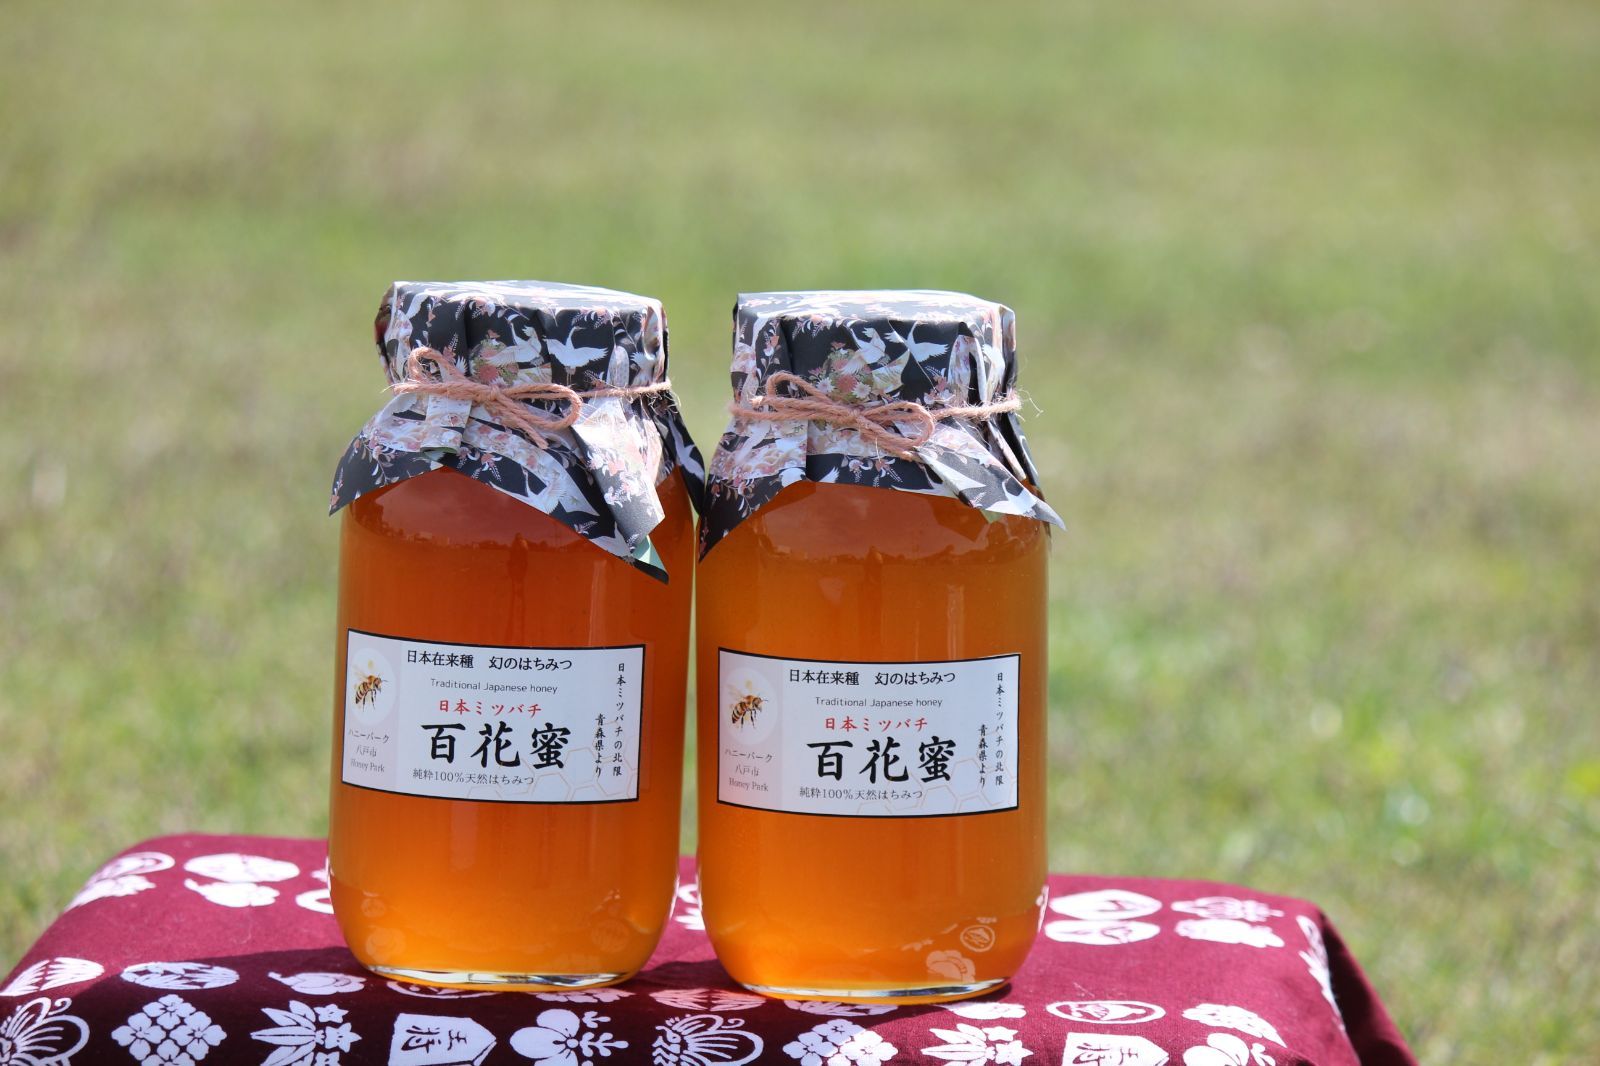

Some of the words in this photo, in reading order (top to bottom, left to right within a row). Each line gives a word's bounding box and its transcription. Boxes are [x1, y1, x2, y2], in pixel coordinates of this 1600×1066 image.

[407, 649, 474, 669] 日本在来種
[489, 655, 573, 671] 幻のはちみつ
[430, 678, 480, 691] Traditional
[483, 682, 528, 693] Japanese
[530, 684, 558, 695] honey
[789, 669, 860, 686] 日本在来種
[874, 671, 956, 685] 幻のはちみつ
[439, 699, 542, 718] 日本ミツバチ
[815, 696, 867, 707] Traditional
[870, 699, 914, 709] Japanese
[915, 698, 943, 709] honey
[612, 662, 627, 777] 日本ミツバチの北限
[825, 715, 928, 733] 日本ミツバチ
[994, 672, 1005, 786] 日本ミツバチの北限
[355, 744, 377, 758] 八戸市
[421, 720, 572, 770] 百花蜜
[594, 713, 607, 778] 青森県より
[350, 758, 368, 771] Honey
[370, 763, 385, 772] Park
[807, 735, 957, 784] 百花蜜
[977, 724, 989, 788] 青森県より
[735, 764, 760, 777] 八戸市
[728, 777, 750, 790] Honey
[751, 781, 769, 792] Park
